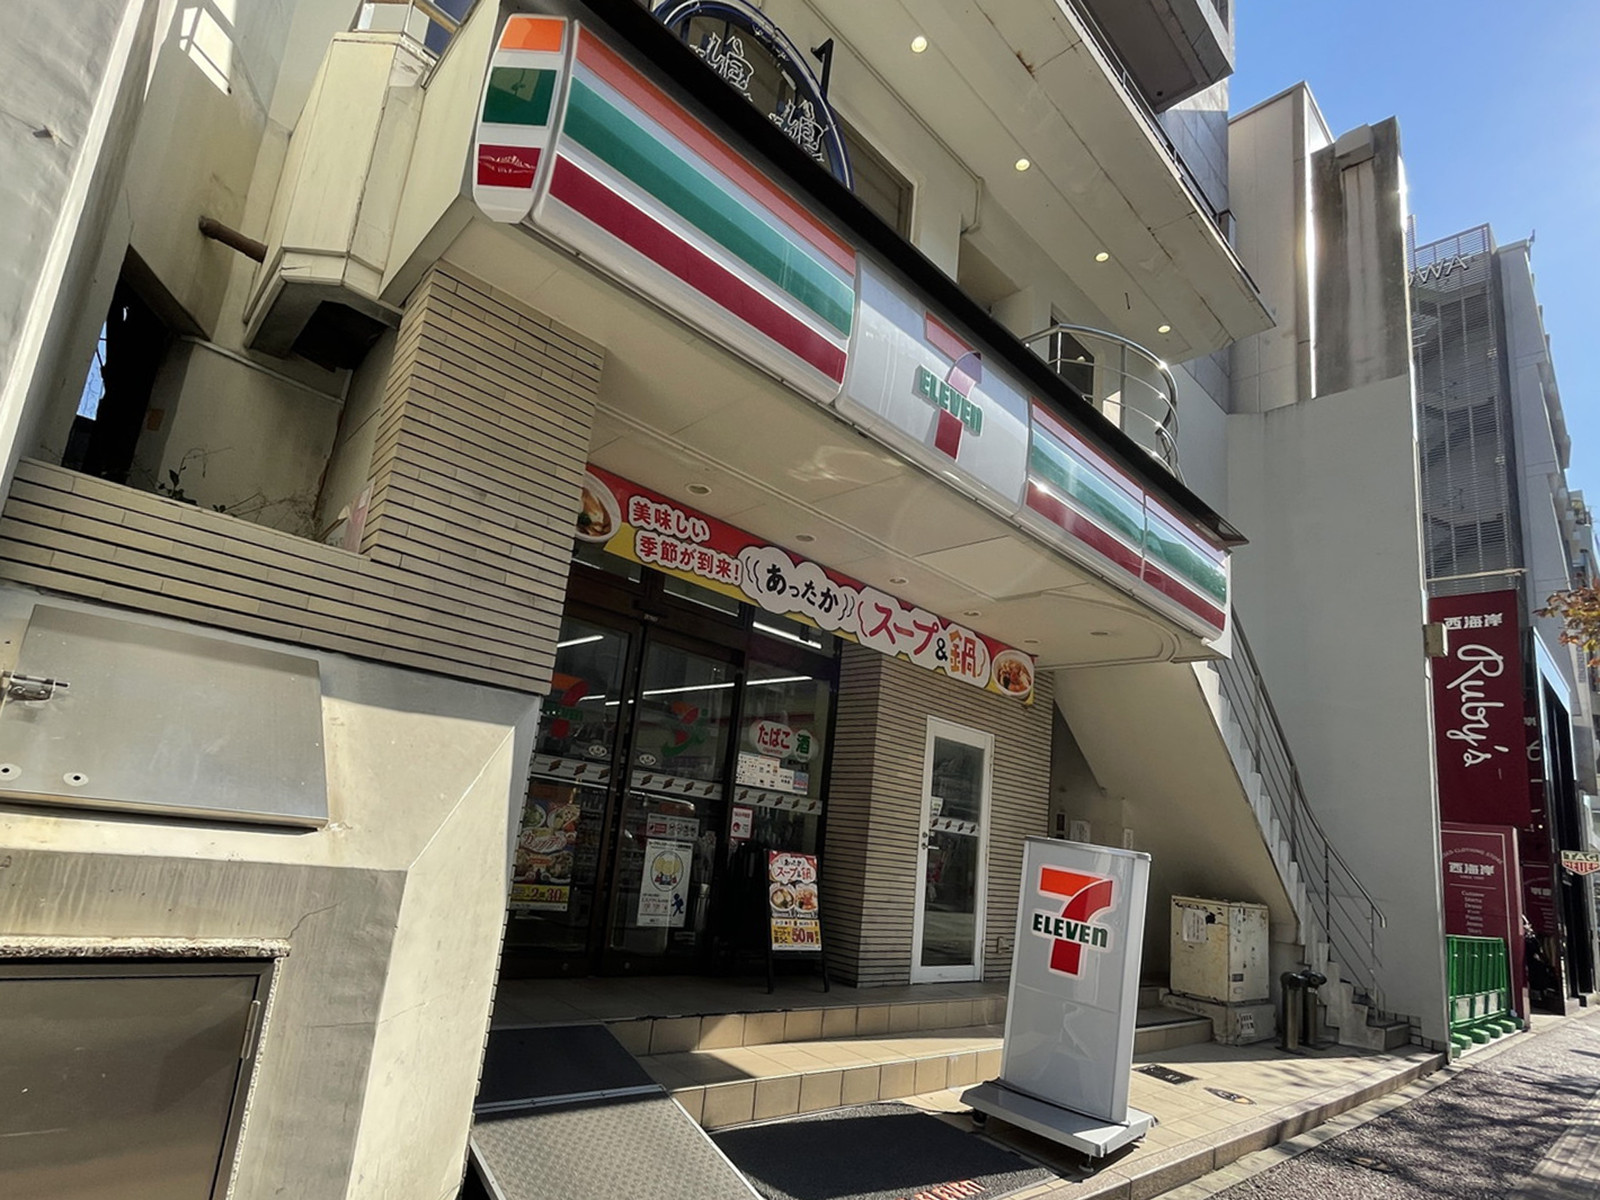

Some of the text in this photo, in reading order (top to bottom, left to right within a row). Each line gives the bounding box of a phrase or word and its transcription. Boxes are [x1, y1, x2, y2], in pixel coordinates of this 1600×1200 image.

[633, 501, 707, 538] 美味しい
[640, 535, 740, 581] 季節が到来!
[766, 563, 840, 614] あったか
[1443, 612, 1503, 631] 西海岸
[1446, 643, 1510, 768] Ruby's
[757, 724, 811, 755] たばこ 酒
[1564, 861, 1599, 873] HEUER
[1565, 851, 1599, 862] TAG
